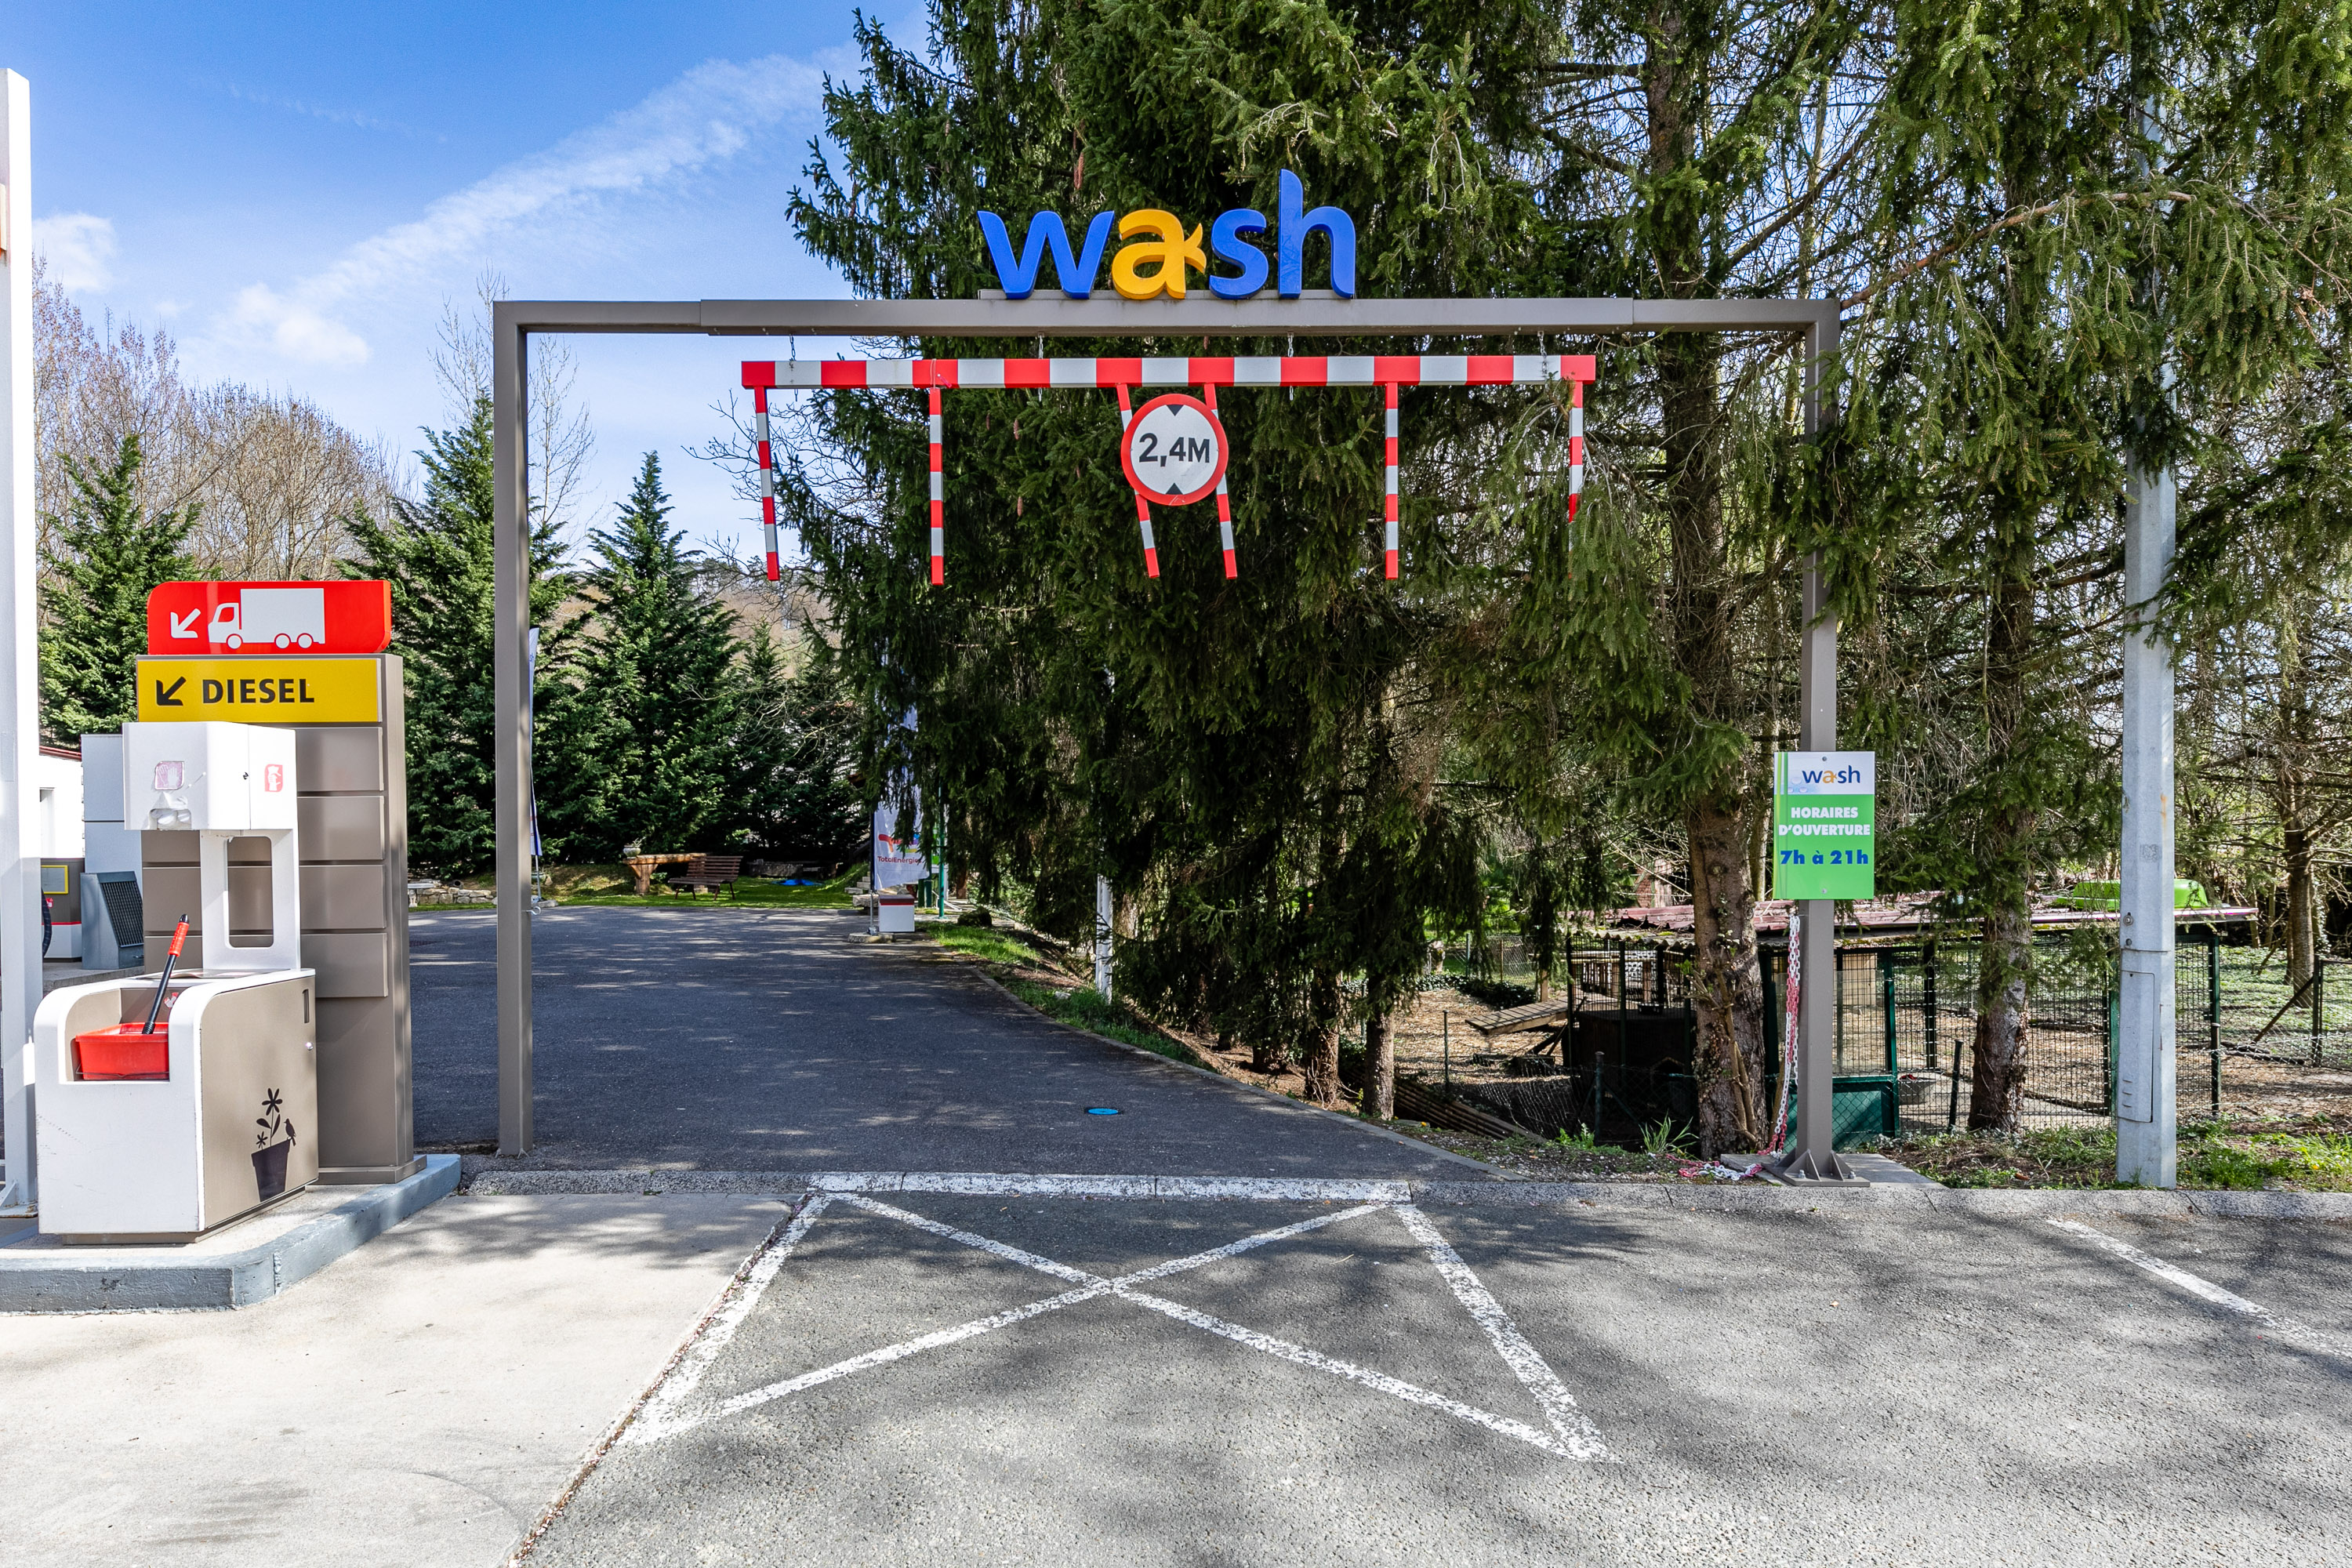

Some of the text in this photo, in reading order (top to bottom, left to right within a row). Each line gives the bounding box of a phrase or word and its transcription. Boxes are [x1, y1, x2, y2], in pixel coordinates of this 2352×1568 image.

[978, 169, 1356, 299] wash
[1139, 433, 1210, 467] 2,4M
[202, 679, 314, 703] DIESEL
[1802, 765, 1860, 784] wash
[1791, 807, 1858, 818] HORAIRES
[1778, 824, 1871, 836] D'OUVERTURE
[1780, 849, 1869, 865] 7h à 21h
